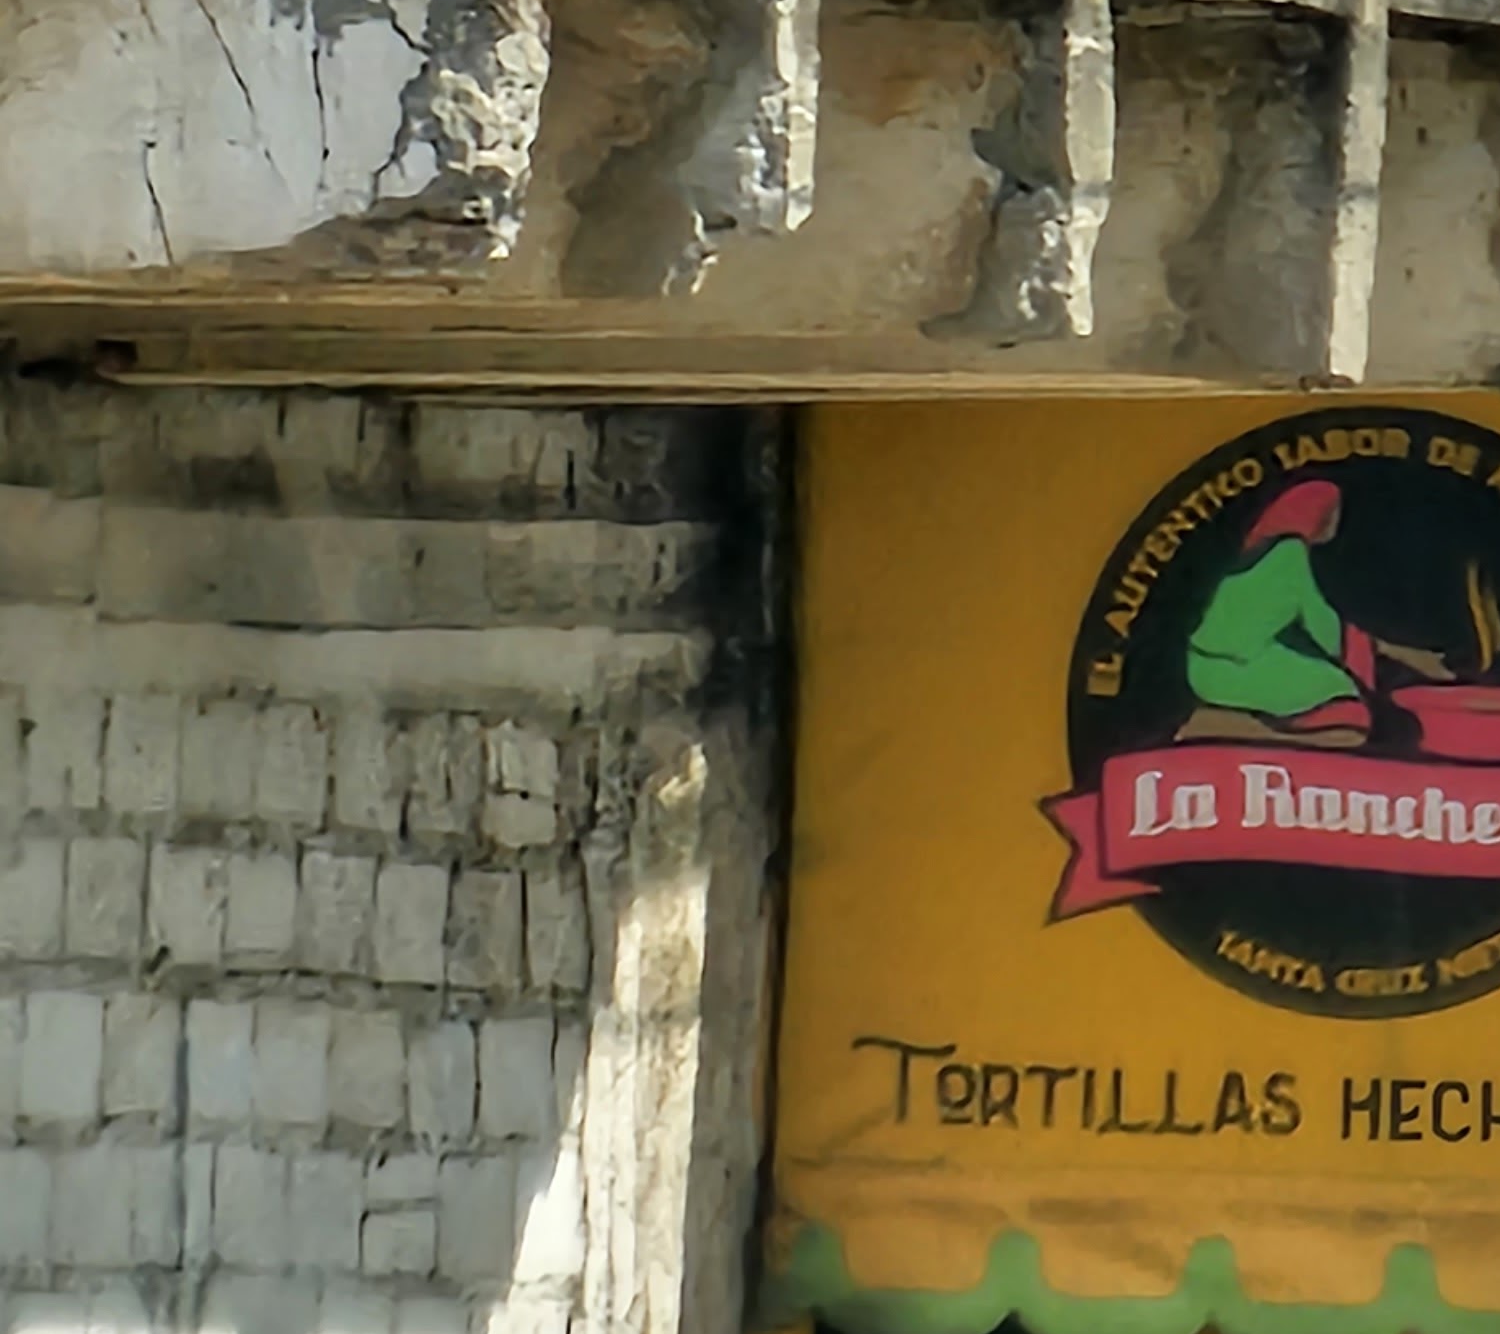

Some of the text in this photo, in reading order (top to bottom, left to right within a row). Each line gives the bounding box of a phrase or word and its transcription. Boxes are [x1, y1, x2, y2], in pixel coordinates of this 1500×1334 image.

[1426, 434, 1482, 476] DE
[1104, 457, 1264, 639] AUTENTICO
[1087, 652, 1124, 698] EL
[1129, 769, 1219, 836] La
